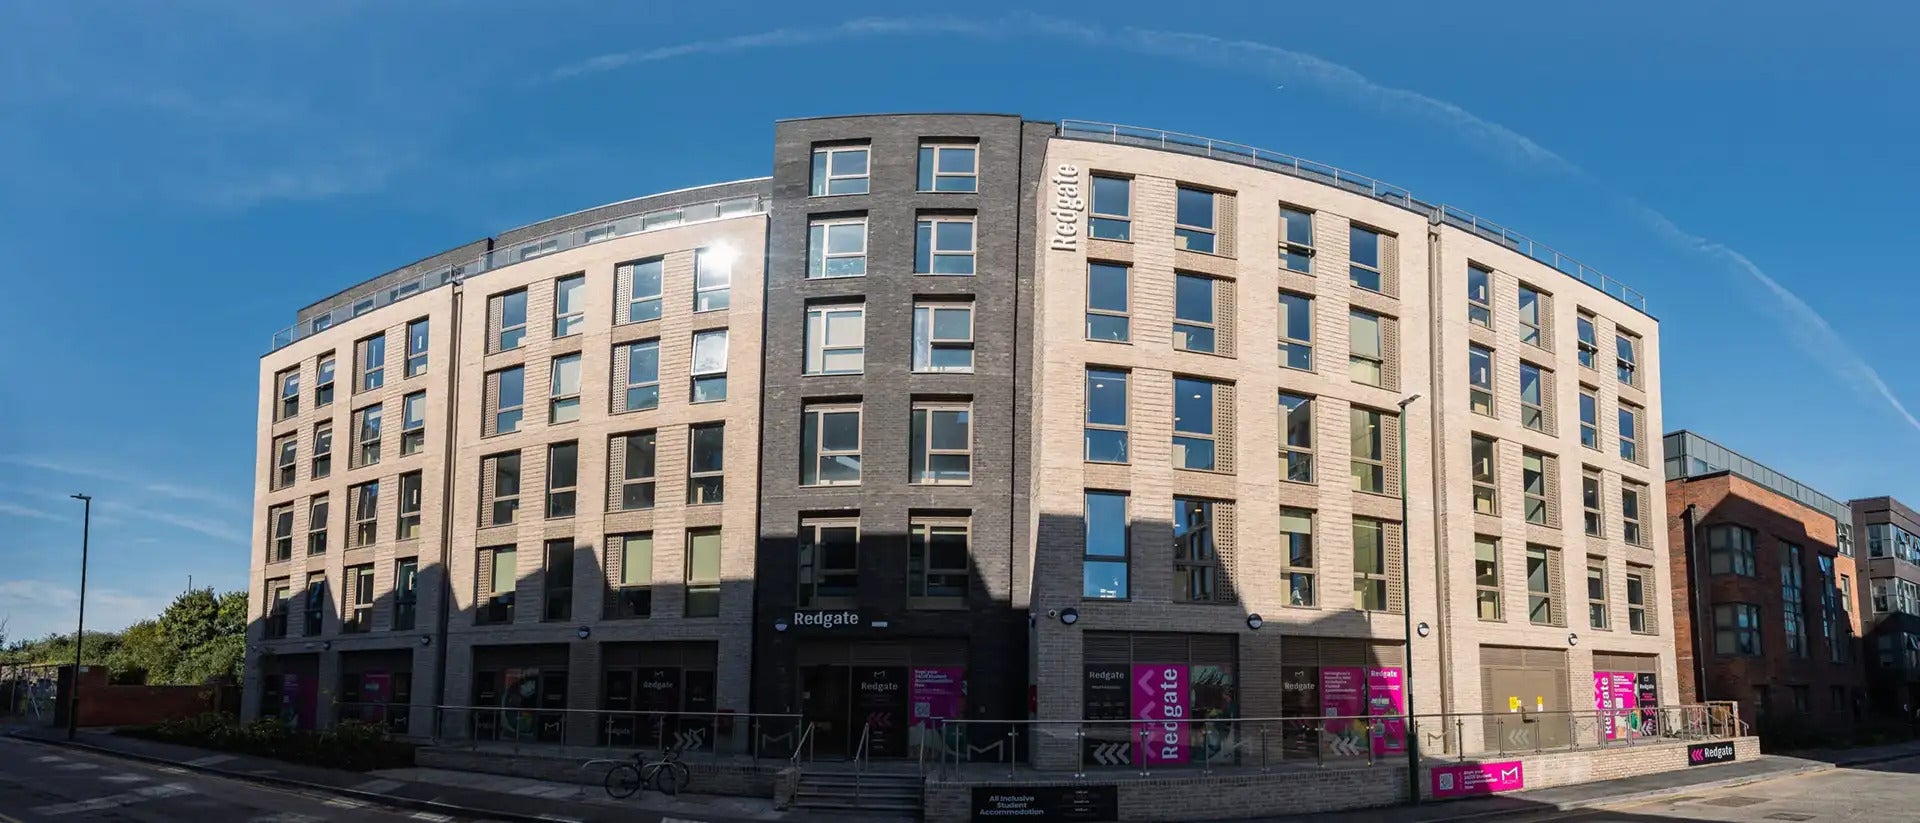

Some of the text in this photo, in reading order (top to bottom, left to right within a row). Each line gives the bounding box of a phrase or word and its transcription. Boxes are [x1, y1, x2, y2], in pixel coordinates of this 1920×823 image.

[1050, 163, 1085, 252] Redgate
[794, 611, 859, 628] Redgate
[1089, 670, 1125, 681] Redgate
[1371, 670, 1398, 680] Redgate
[861, 681, 899, 692] Redgate
[1284, 682, 1316, 692] Redgate
[1160, 668, 1183, 759] Redgate
[1704, 745, 1733, 760] Redgate
[979, 808, 1045, 816] Accommodation
